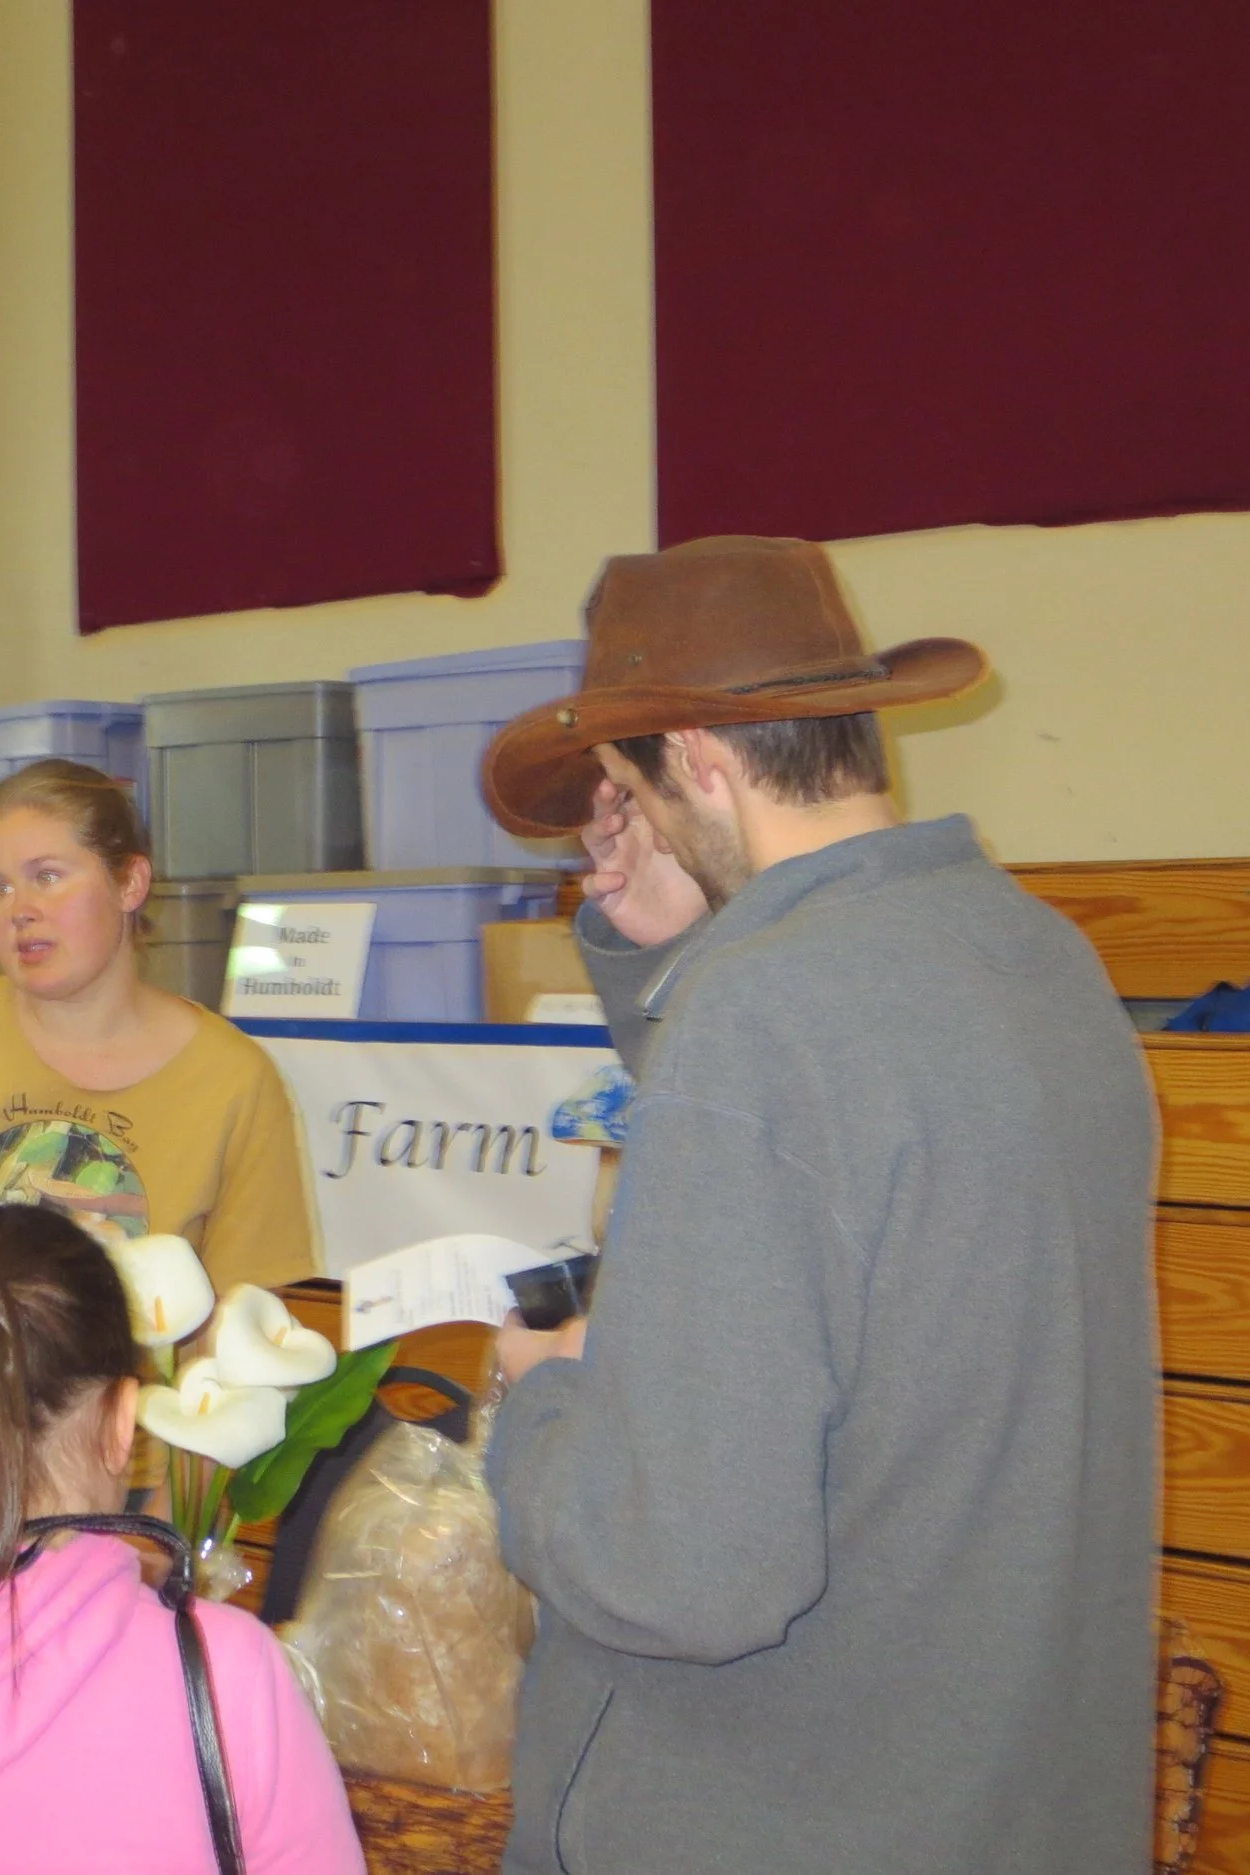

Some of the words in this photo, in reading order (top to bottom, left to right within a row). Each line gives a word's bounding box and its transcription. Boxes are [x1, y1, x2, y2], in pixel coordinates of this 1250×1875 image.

[279, 926, 331, 944] Made
[244, 977, 342, 996] Humboldt
[3, 1092, 97, 1123] Humboldt
[107, 1111, 139, 1153] Bay
[321, 1100, 548, 1180] Farm
